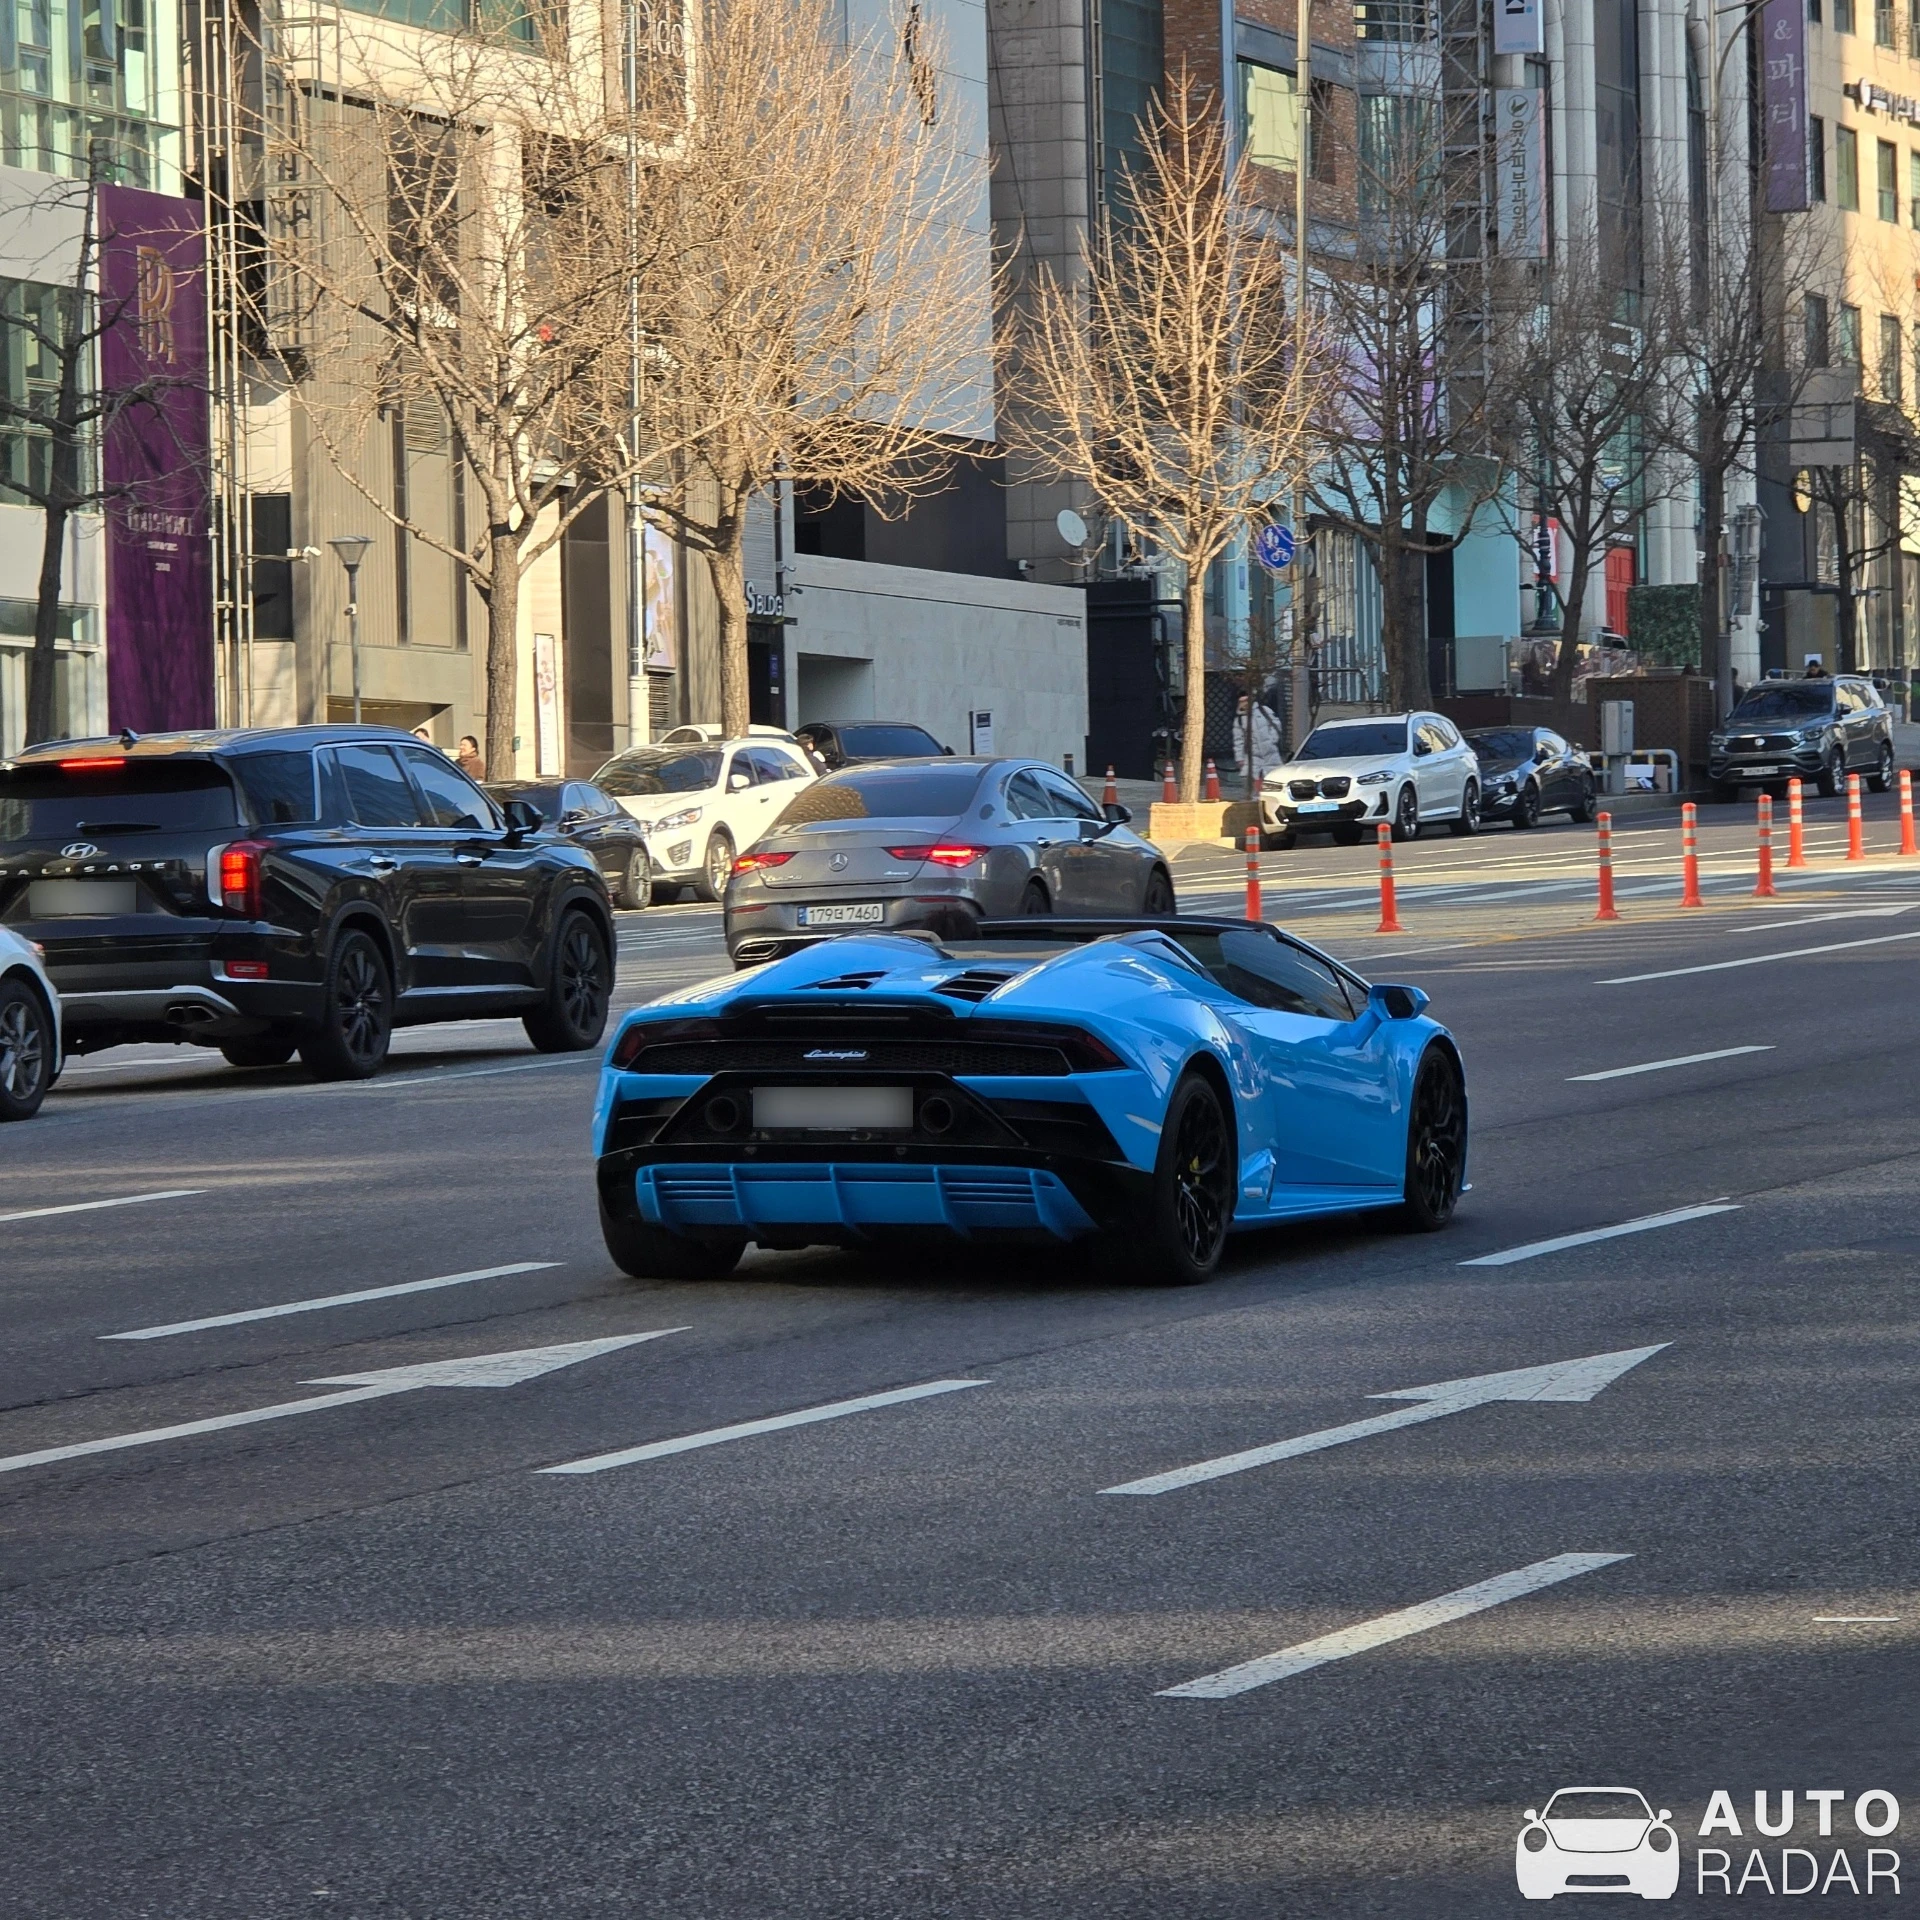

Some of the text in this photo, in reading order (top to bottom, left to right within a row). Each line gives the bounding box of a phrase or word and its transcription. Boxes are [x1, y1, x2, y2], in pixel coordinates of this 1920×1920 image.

[1767, 53, 1802, 133] 파티
[809, 906, 880, 923] 179더 7460
